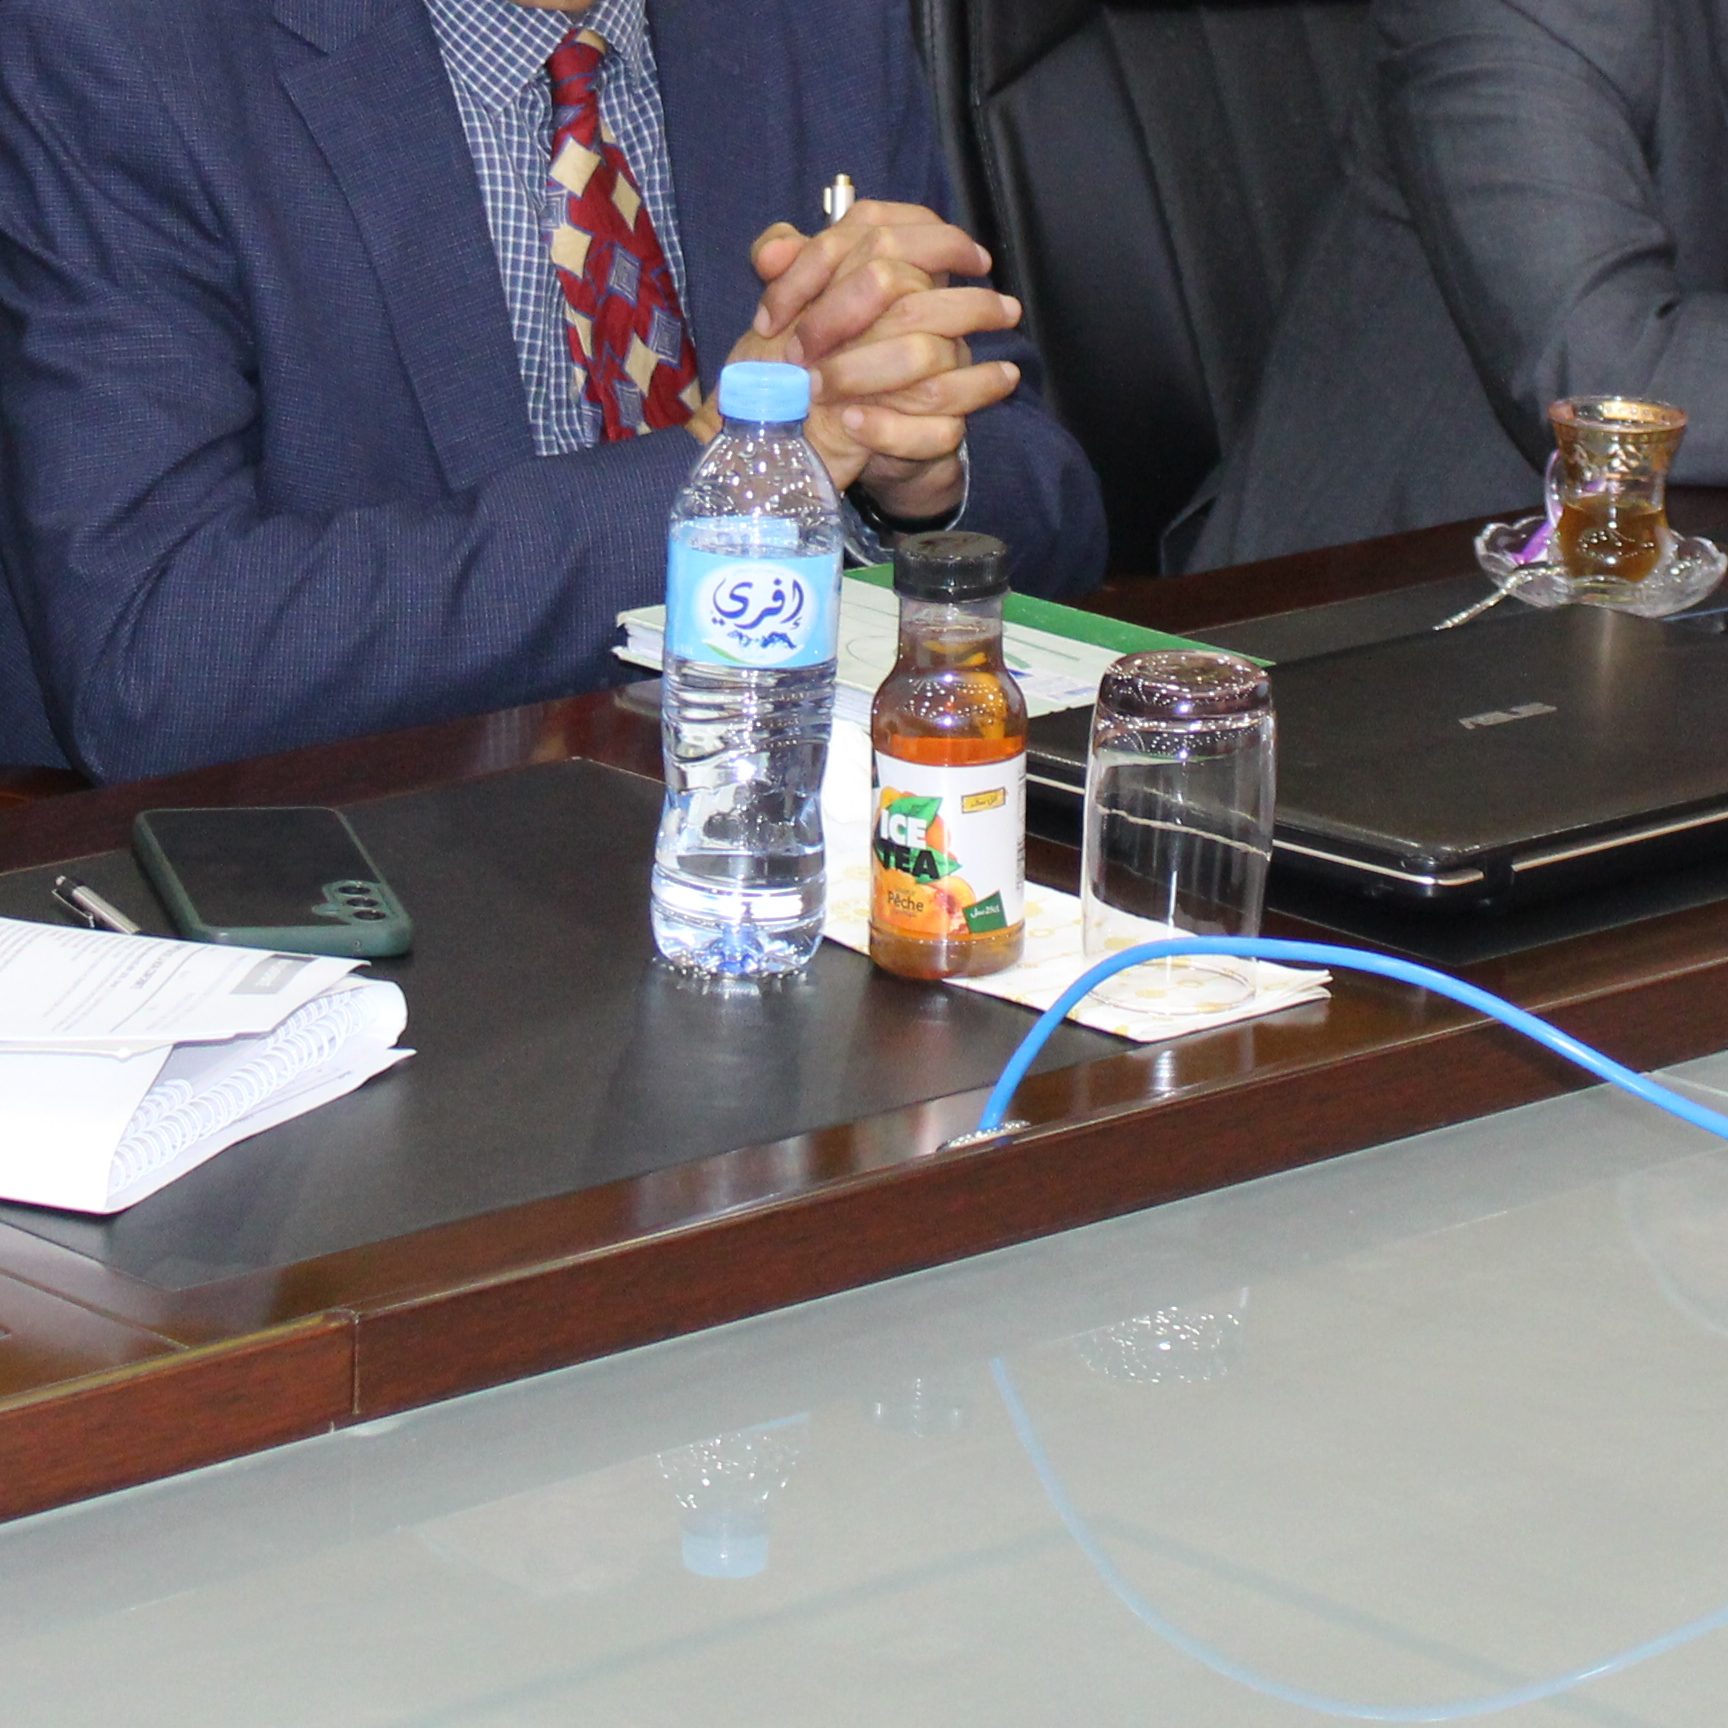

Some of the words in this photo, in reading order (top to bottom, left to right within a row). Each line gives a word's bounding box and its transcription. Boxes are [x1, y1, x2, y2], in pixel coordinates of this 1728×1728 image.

[710, 577, 805, 630] إفري
[879, 808, 927, 849] ICE
[879, 843, 941, 880] TEA
[887, 890, 925, 912] Pêche
